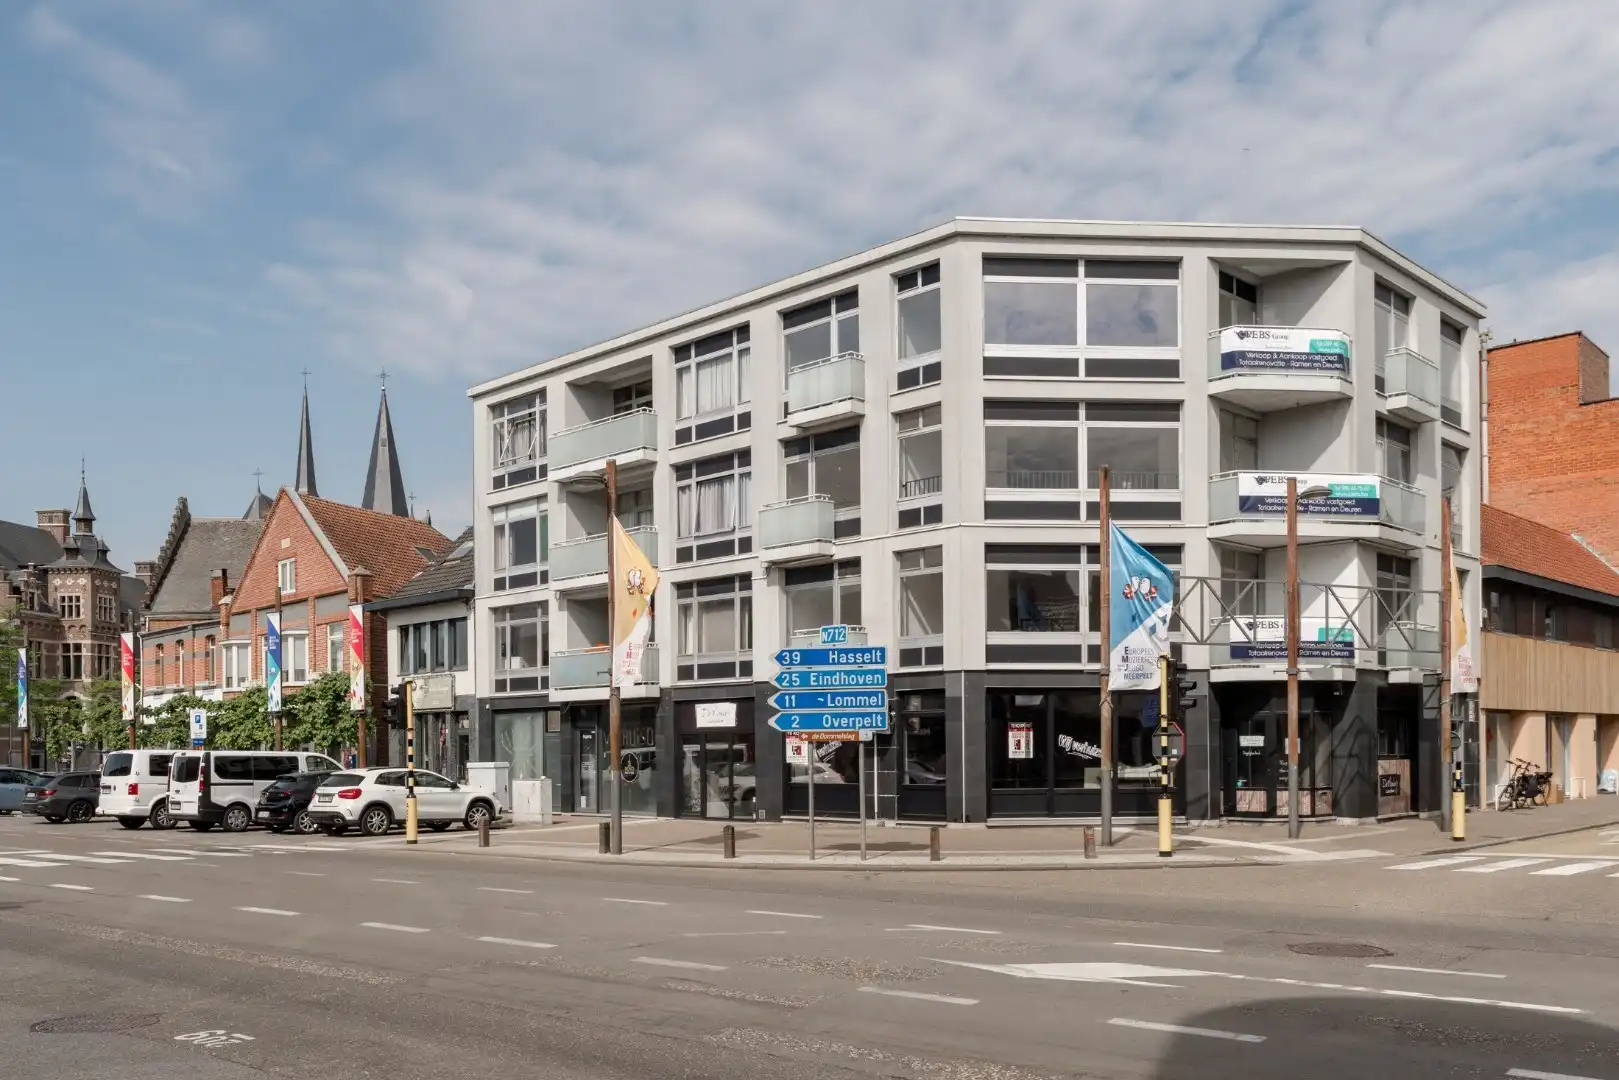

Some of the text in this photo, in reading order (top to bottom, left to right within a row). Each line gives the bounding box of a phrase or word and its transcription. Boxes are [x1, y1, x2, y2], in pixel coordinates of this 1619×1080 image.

[1245, 352, 1271, 360] Verkoop
[1279, 353, 1308, 361] Aankoop
[1309, 354, 1338, 362] vastgoed
[1308, 504, 1330, 512] Ramen
[1341, 505, 1362, 513] Deuren
[1326, 498, 1355, 507] vastgoed
[821, 628, 845, 643] N712
[781, 650, 882, 664] 39 Hasselt
[781, 672, 882, 686] 25 Eindhoven
[784, 693, 882, 708] 11 Lommel
[791, 714, 882, 729] 2 Overpelt
